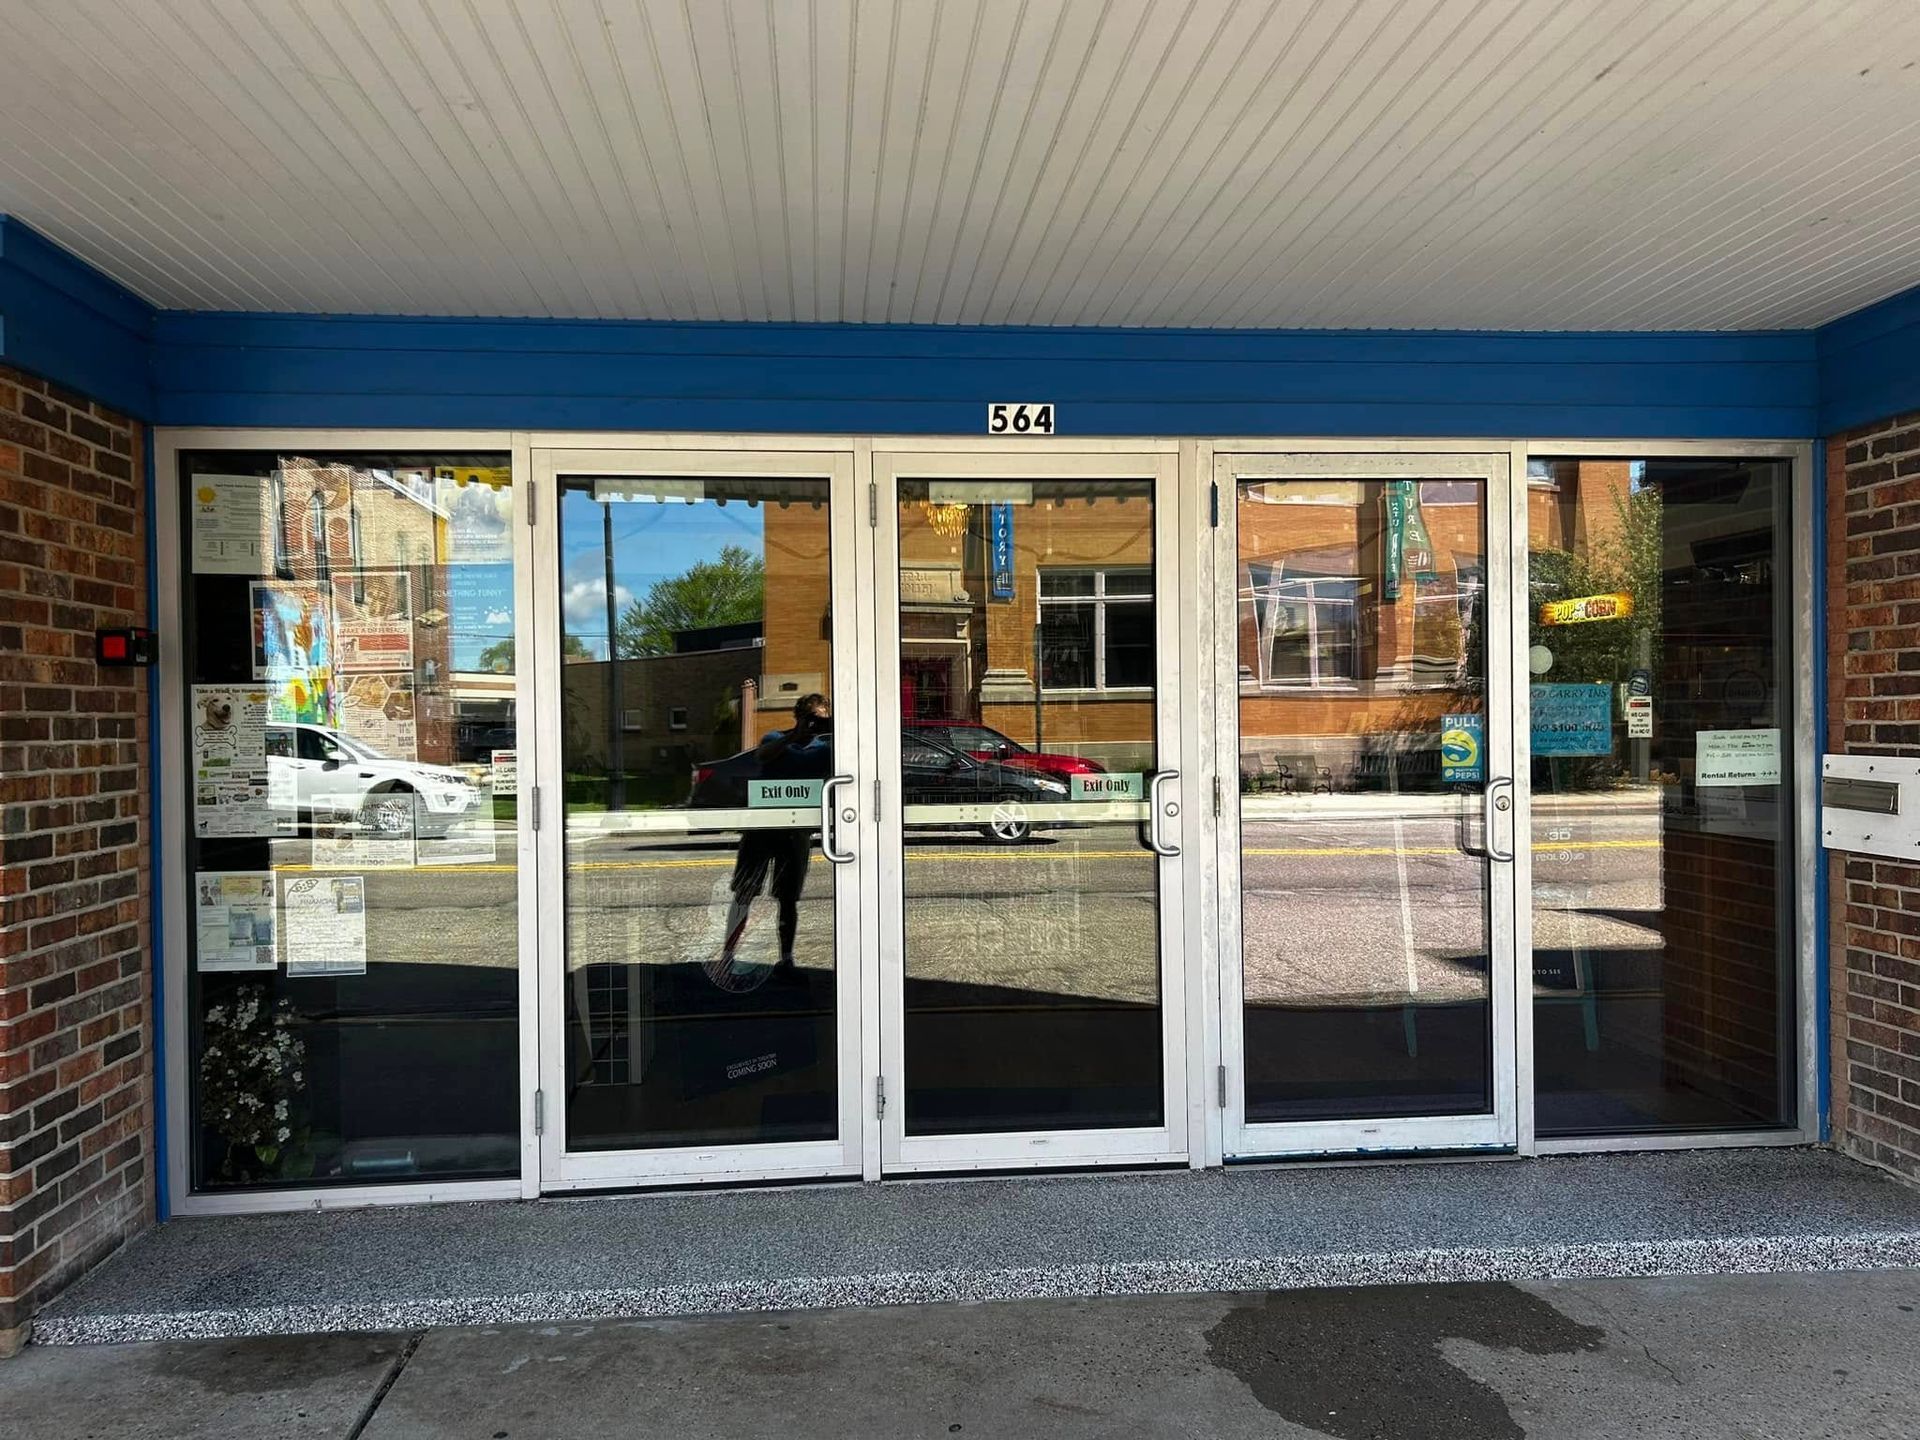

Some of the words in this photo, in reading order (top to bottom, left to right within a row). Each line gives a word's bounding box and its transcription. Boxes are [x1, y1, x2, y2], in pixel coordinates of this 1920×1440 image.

[991, 405, 1052, 432] 564
[1549, 688, 1586, 698] CARRY
[1445, 717, 1479, 728] PULL
[1456, 771, 1480, 780] PEPSI
[761, 786, 782, 799] Exit
[785, 785, 811, 799] Only
[1083, 780, 1103, 792] Exit
[1106, 779, 1130, 793] Only
[727, 1064, 756, 1079] COMING
[757, 1058, 778, 1072] SOON
